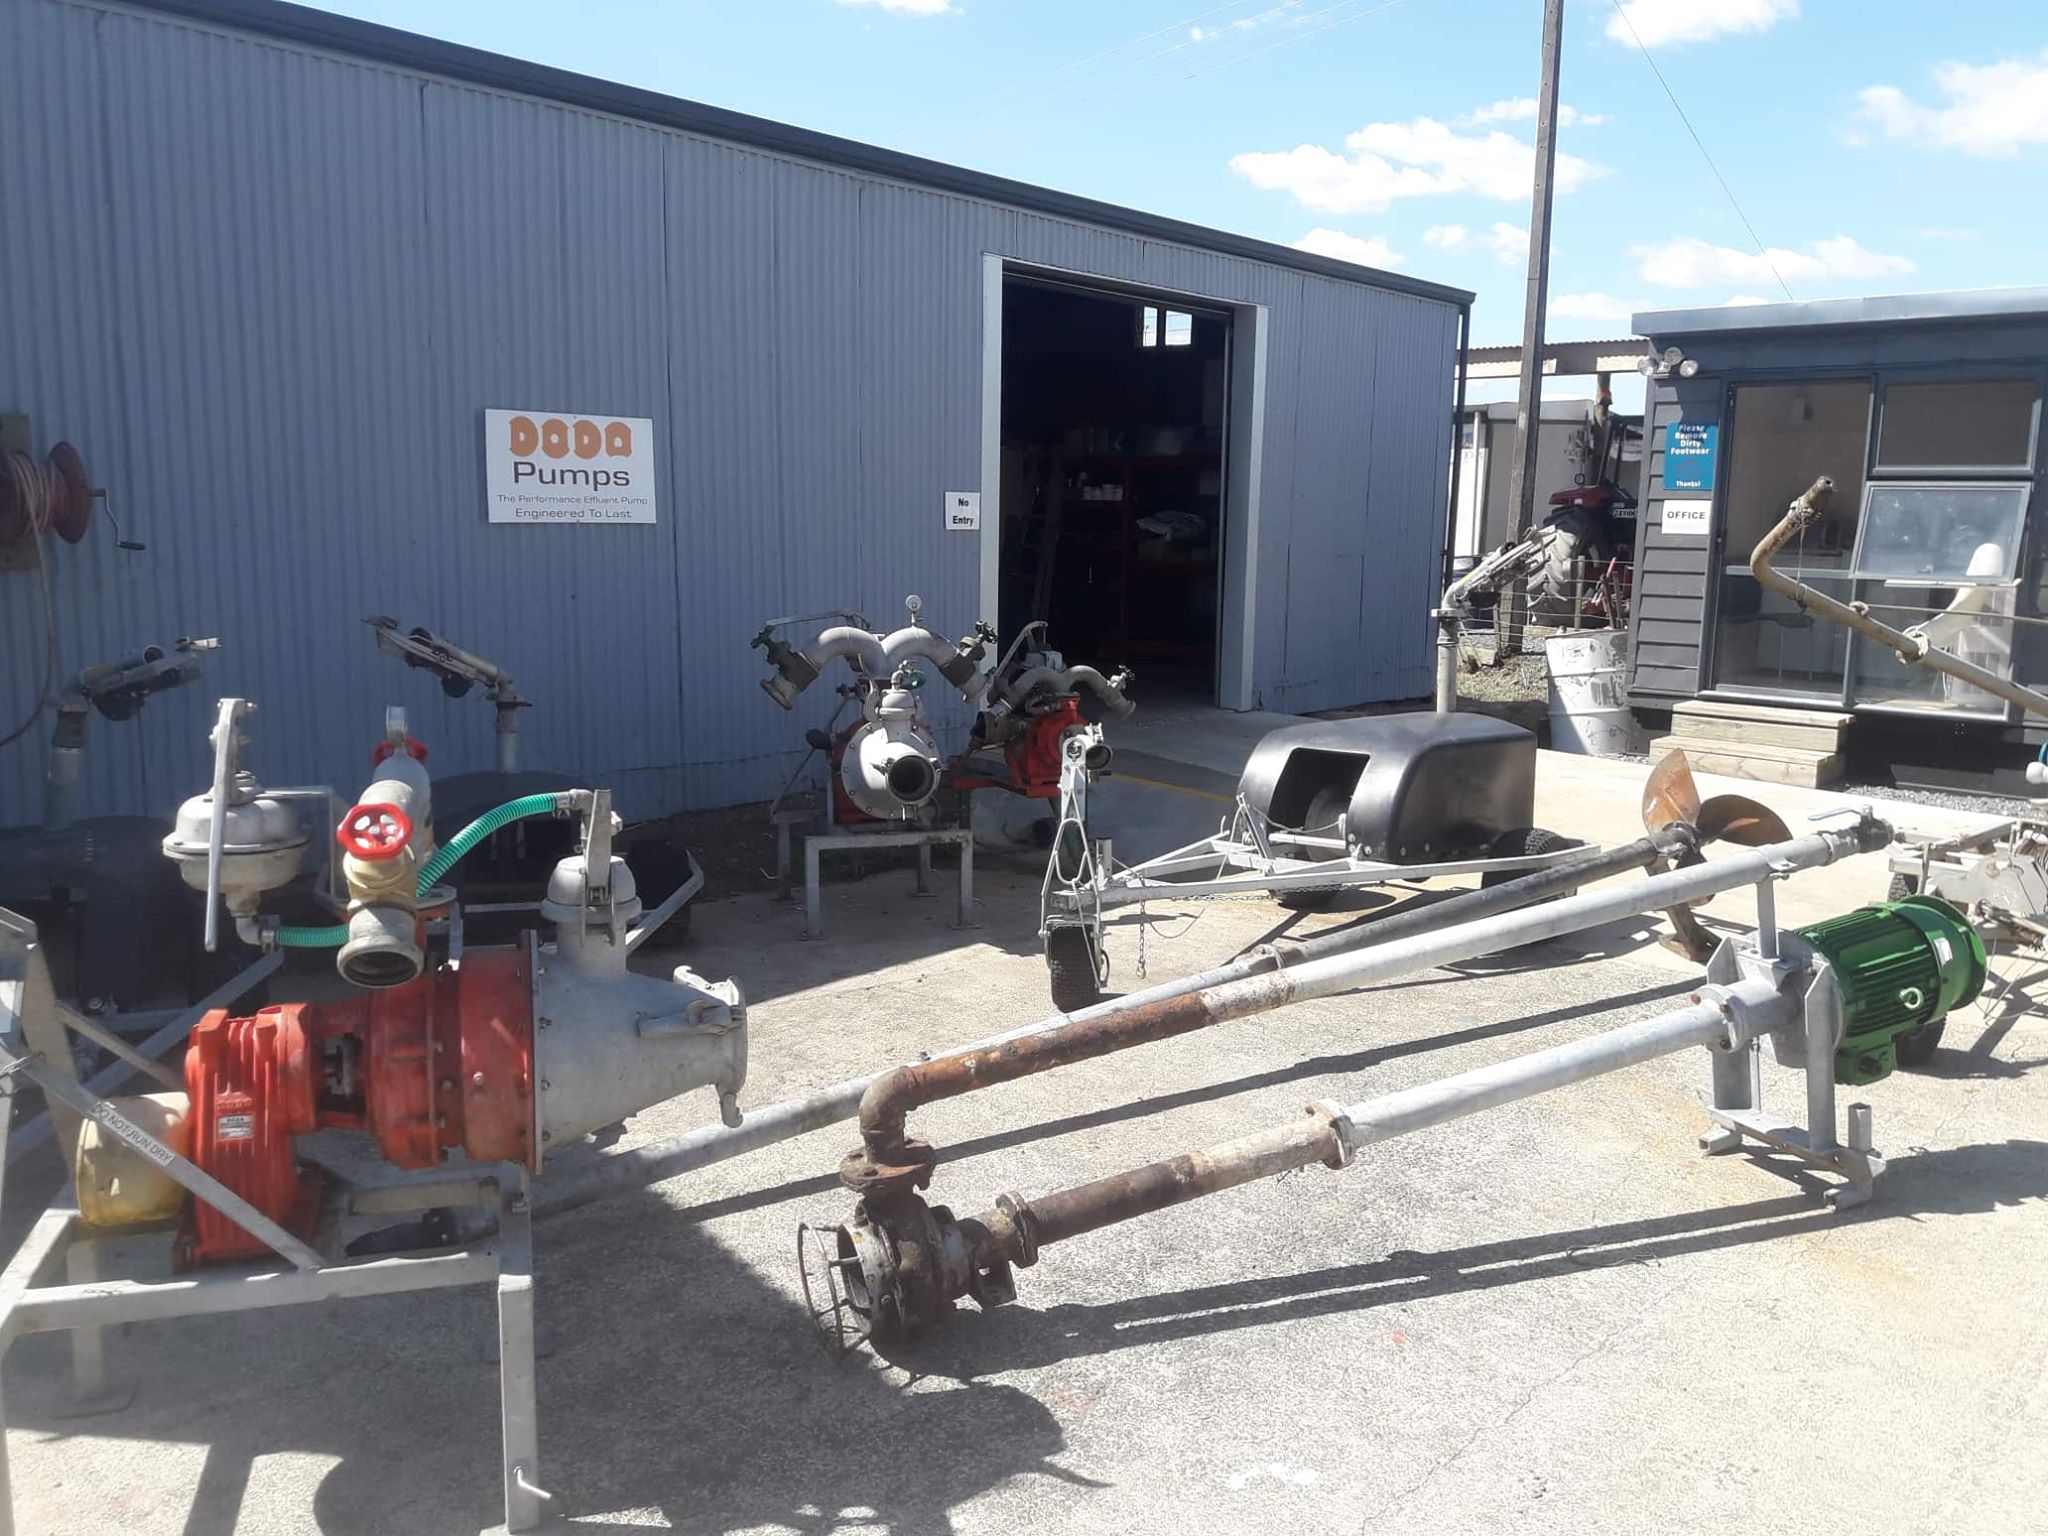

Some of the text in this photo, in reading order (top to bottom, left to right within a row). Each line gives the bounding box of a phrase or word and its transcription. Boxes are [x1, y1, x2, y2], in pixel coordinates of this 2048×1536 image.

[509, 416, 632, 459] DODA
[1674, 431, 1708, 440] Remove
[1680, 440, 1701, 448] Dirty
[1670, 447, 1710, 455] Footwear
[513, 461, 630, 491] Pumps
[497, 494, 648, 505] The Performance Effluent Pump
[958, 498, 969, 506] No
[515, 508, 633, 520] Engineered To Last
[1666, 511, 1706, 519] OFFICE
[952, 515, 974, 526] Entry
[107, 1114, 130, 1134] NOT
[126, 1129, 151, 1149] RUN
[150, 1144, 173, 1162] DRY
